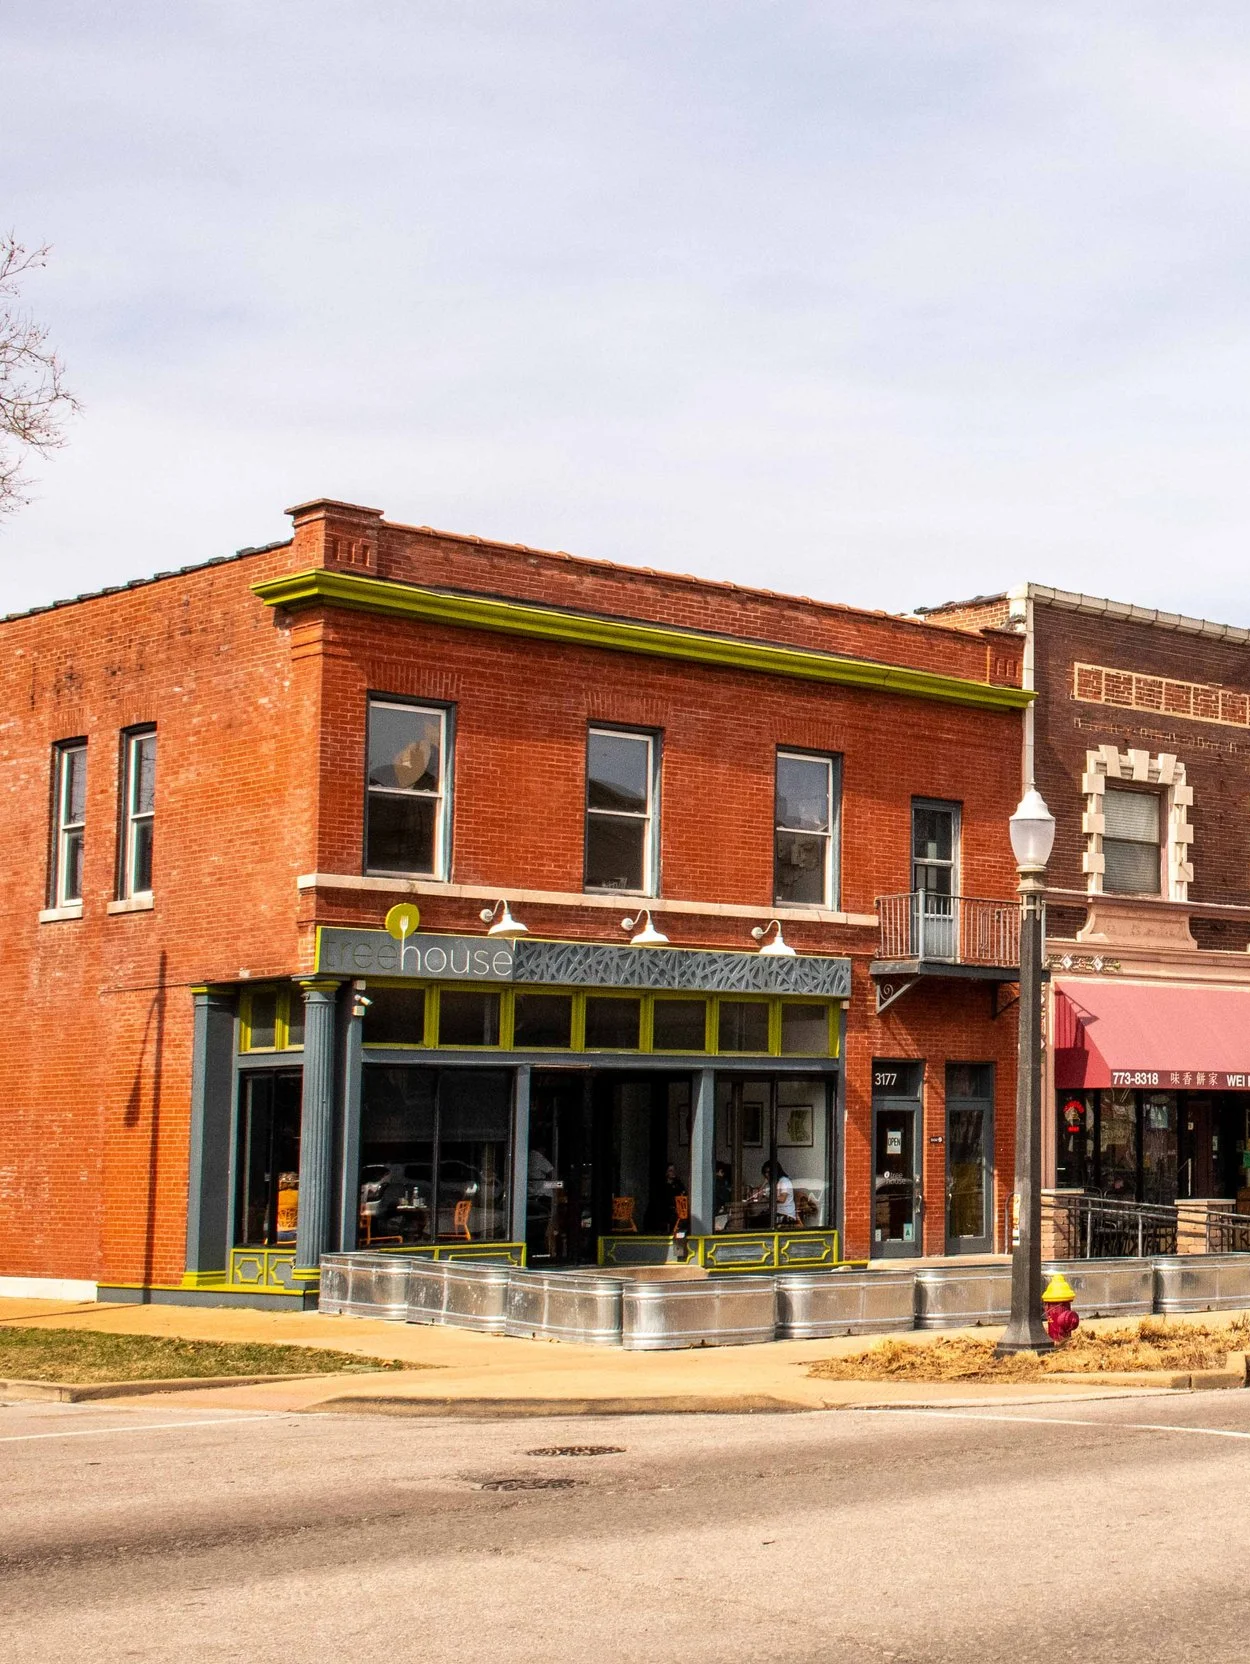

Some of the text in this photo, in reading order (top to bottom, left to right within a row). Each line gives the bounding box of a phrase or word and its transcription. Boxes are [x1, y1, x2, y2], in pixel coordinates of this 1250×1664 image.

[875, 1072, 897, 1086] 3177
[1113, 1072, 1159, 1086] 773-8318
[1226, 1074, 1245, 1087] WEI
[888, 1137, 901, 1146] OPEN
